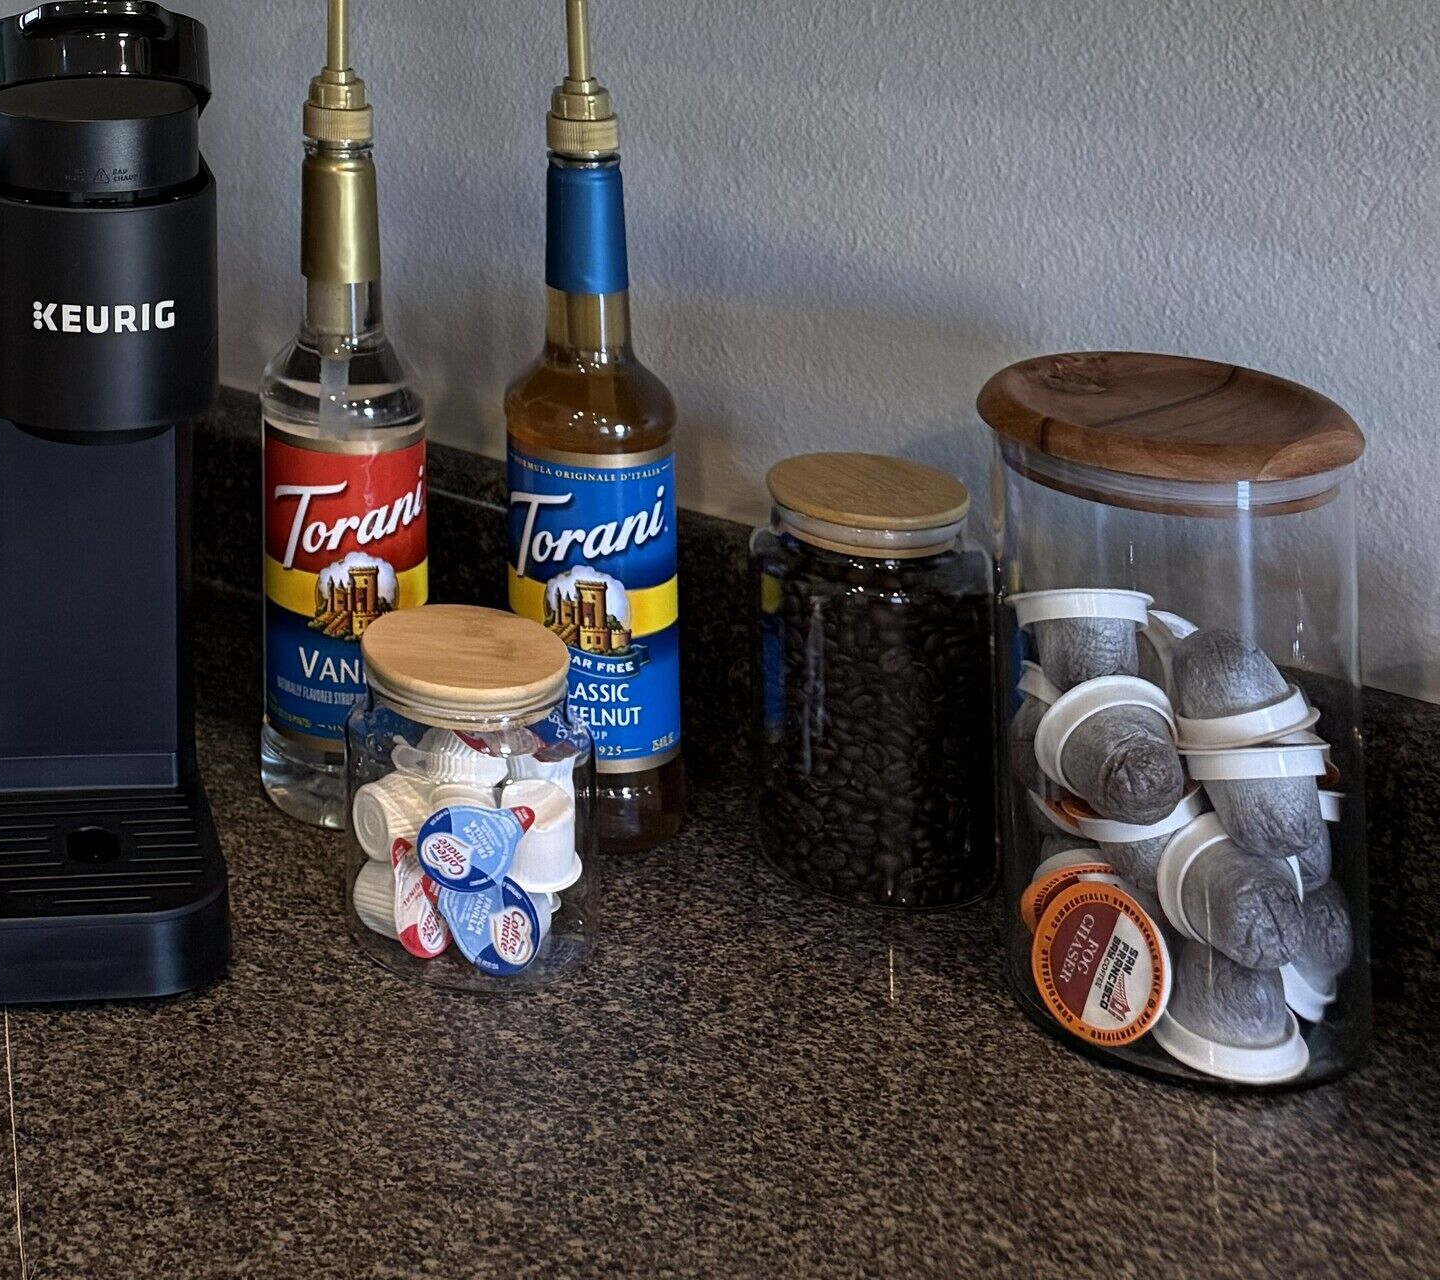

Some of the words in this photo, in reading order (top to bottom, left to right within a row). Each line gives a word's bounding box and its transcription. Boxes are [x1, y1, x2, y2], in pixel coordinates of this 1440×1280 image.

[32, 300, 176, 334] KEURIG
[555, 470, 616, 482] ORIGINALE
[274, 465, 424, 569] Torani
[510, 485, 665, 577] Torani
[596, 661, 635, 673] FREE
[598, 745, 623, 756] 925
[432, 842, 465, 875] Coffee
[439, 838, 467, 863] mate
[500, 914, 510, 954] mate
[509, 910, 526, 955] Coffee
[1060, 913, 1095, 983] CHASER
[1078, 938, 1100, 976] FOG
[1095, 958, 1111, 989] COFFEE
[1123, 947, 1139, 976] SAN
[1099, 940, 1130, 1011] FRANCISCO
